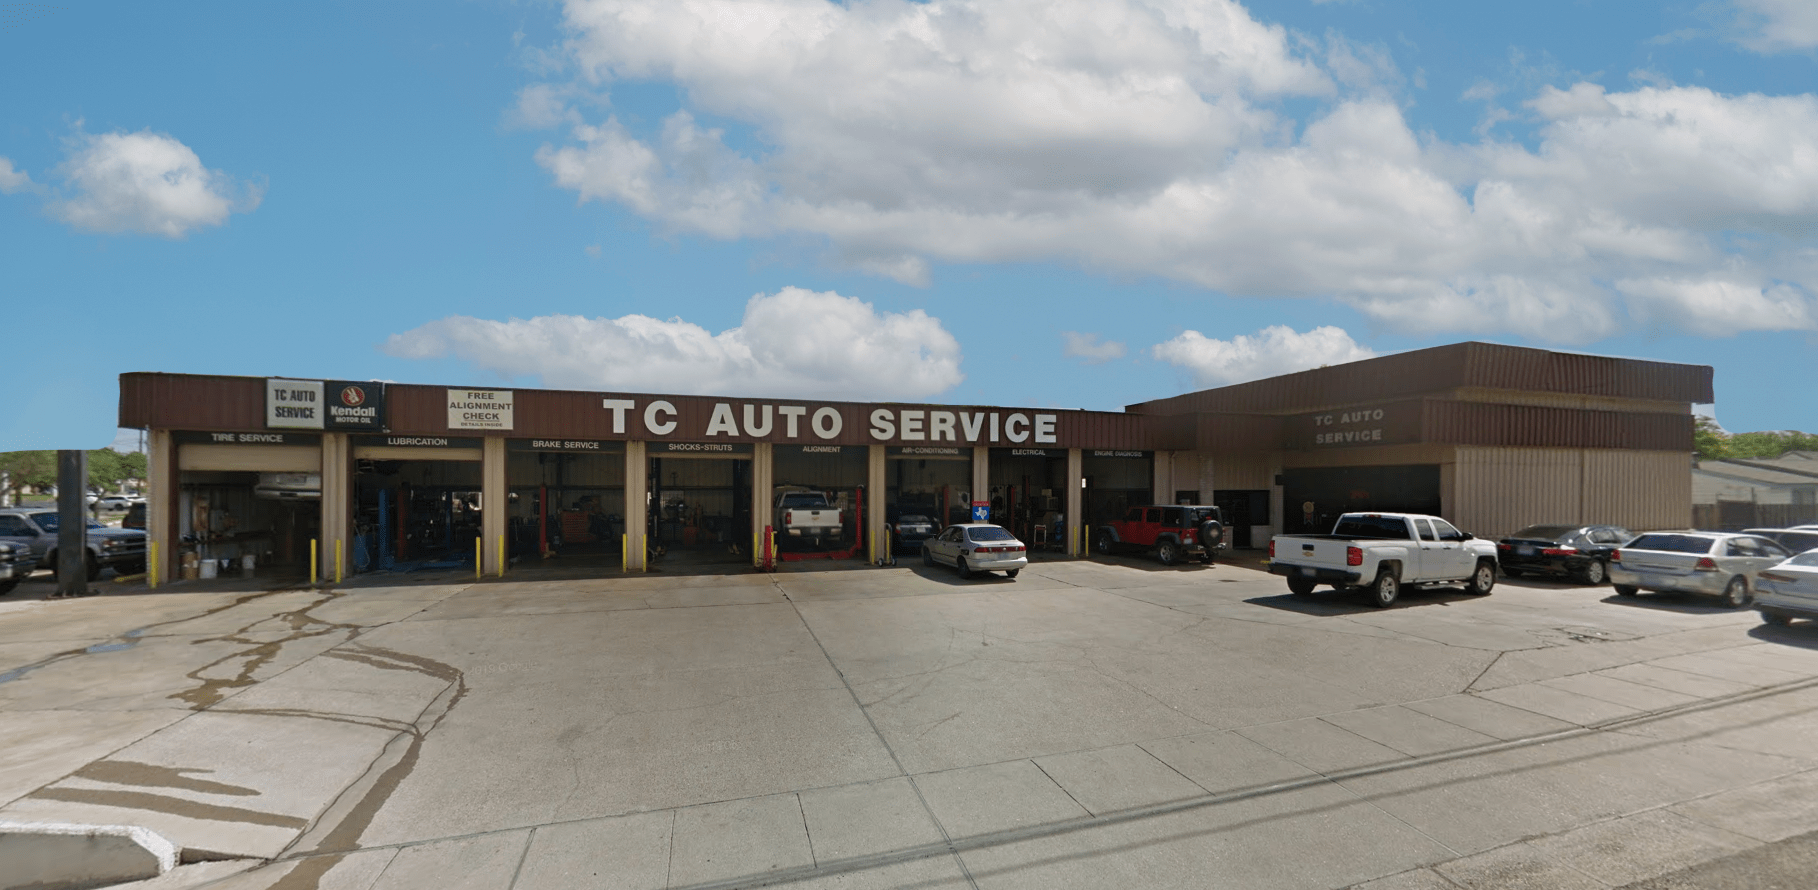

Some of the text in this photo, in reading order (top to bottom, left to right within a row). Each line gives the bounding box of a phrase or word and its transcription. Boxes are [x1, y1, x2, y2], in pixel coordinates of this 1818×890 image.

[274, 389, 316, 402] TC AUTO
[467, 392, 494, 400] FREE
[449, 402, 512, 410] ALIGNMENT
[275, 406, 315, 419] SERVICE
[330, 405, 375, 417] Kendall
[463, 412, 500, 420] CHECK
[1314, 408, 1384, 426] TC AUTO
[603, 399, 1057, 444] TC AUTO SERVICE
[211, 433, 283, 443] TIRE SERVICE
[1315, 429, 1382, 444] SERVICE
[388, 437, 448, 446] LUBRICATION
[532, 440, 599, 449] BRAKE SERVICE
[668, 443, 733, 451] SHOCKS-STRUTS
[902, 447, 959, 455] AIR-CONDITIONING
